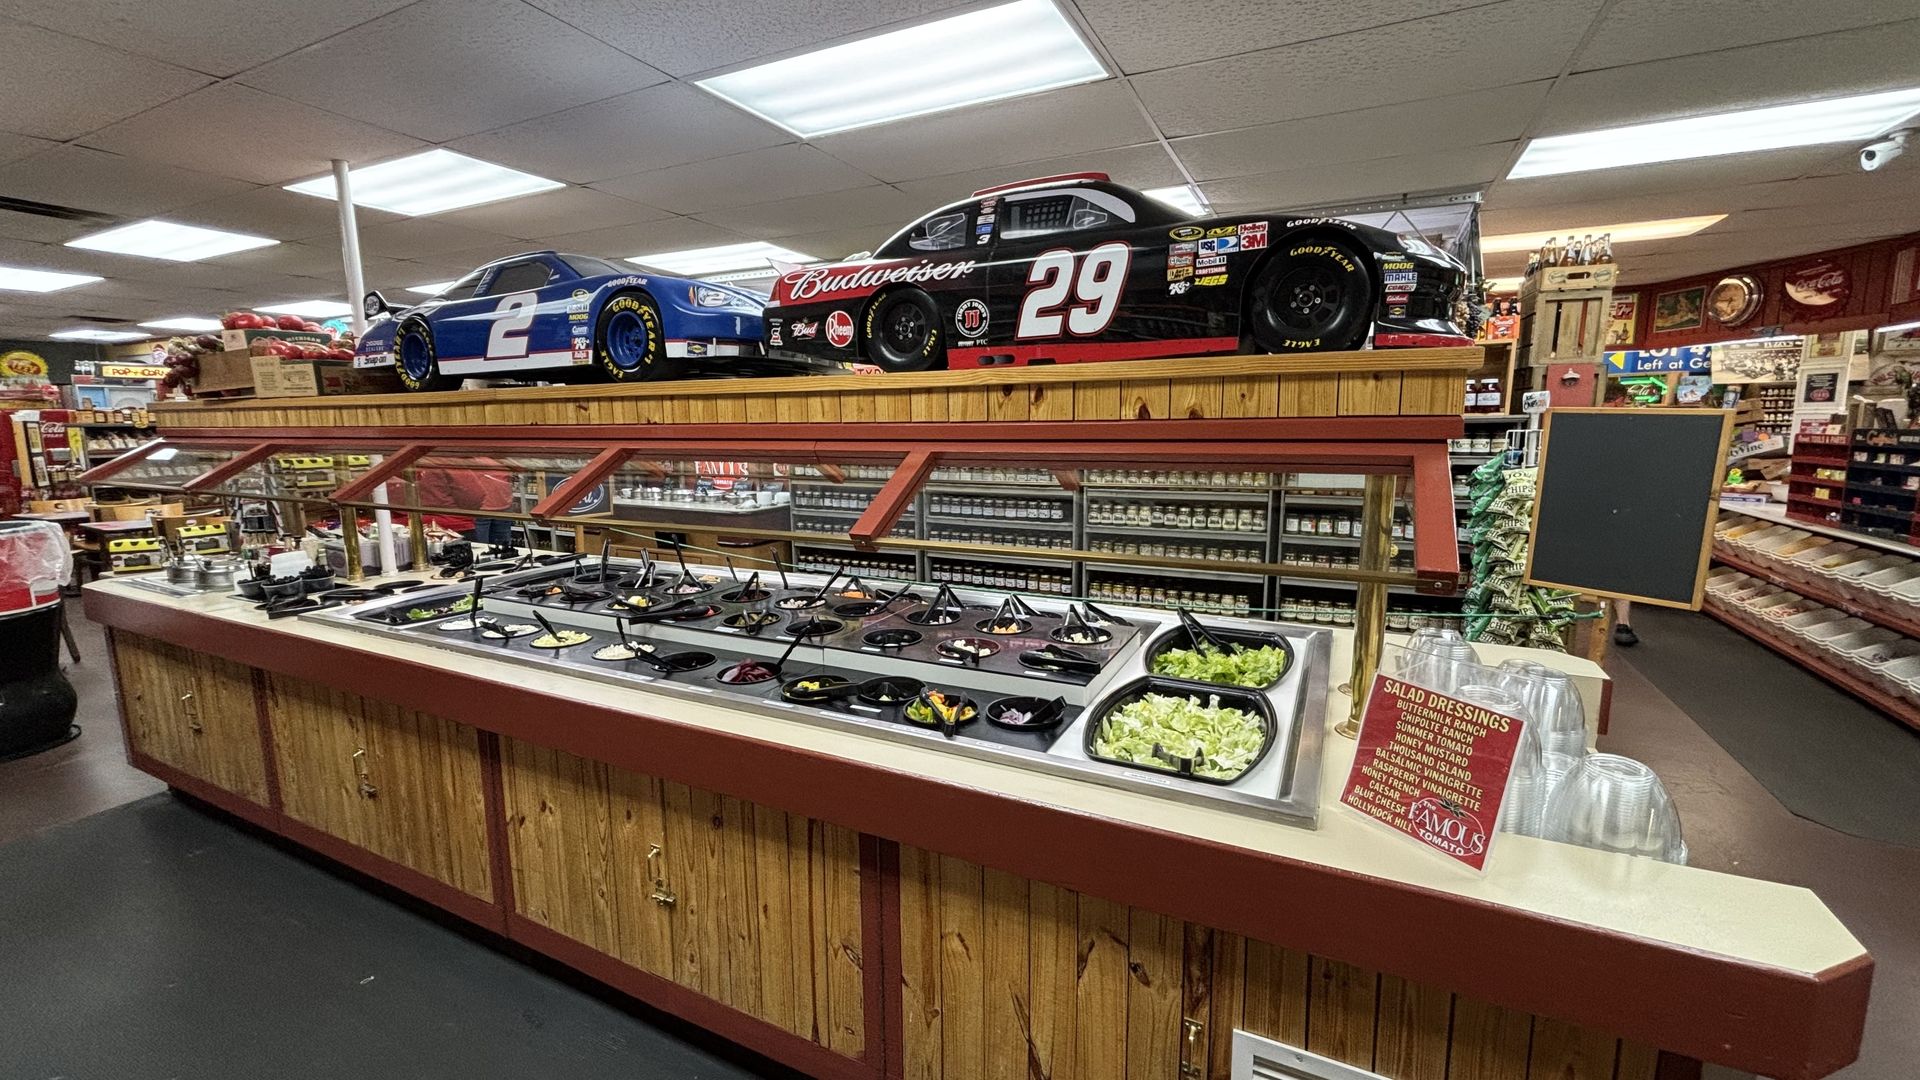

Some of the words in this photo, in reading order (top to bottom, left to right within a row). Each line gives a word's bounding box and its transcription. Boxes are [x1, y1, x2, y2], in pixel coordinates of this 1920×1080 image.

[1286, 217, 1357, 230] GOODYEAR
[976, 234, 991, 245] 3
[1200, 240, 1216, 252] USG
[1242, 234, 1266, 249] 3M
[1198, 258, 1217, 266] Mobil
[1290, 246, 1355, 273] GOODYEAR
[607, 276, 648, 288] GOODYEAR
[784, 259, 976, 300] Budweiser
[1385, 273, 1417, 281] MAHLE
[1014, 240, 1132, 341] 29
[483, 291, 538, 361] 2
[612, 299, 656, 352] GOODYEAR
[791, 321, 819, 337] Bud
[828, 312, 853, 341] Rheem
[1282, 338, 1321, 348] EAGLE
[1637, 359, 1663, 371] Left
[1669, 361, 1684, 370] at
[1493, 500, 1515, 511] HIPS
[1487, 529, 1507, 541] HIPS
[1503, 519, 1526, 528] HIPS
[1508, 562, 1525, 571] HIP
[1492, 594, 1515, 604] HIPS
[1481, 633, 1502, 645] HIPS
[1489, 620, 1516, 635] CHIPS
[1383, 679, 1425, 704] SALAD
[1427, 692, 1511, 733] DRESSINGS
[1396, 699, 1452, 724] BUTTERMILK
[1453, 718, 1487, 739] RANCH
[1401, 712, 1440, 733] CHIPOLTE
[1442, 726, 1473, 745] RANCH
[1395, 732, 1423, 749] HONEY
[1424, 742, 1469, 767] MUSTARD
[1396, 721, 1434, 741] SUMMER
[1436, 735, 1473, 756] TOMATO
[1389, 741, 1435, 767] THOUSAND
[1436, 760, 1472, 781] ISLAND
[1361, 765, 1387, 782] HONEY
[1388, 776, 1421, 798] FRENCH
[1372, 759, 1421, 785] RASPBERRY
[1422, 776, 1481, 812] VINAIGRETTE
[1375, 747, 1423, 775] BALSALMIC
[1424, 764, 1483, 800] VINAIGRETTE
[1354, 785, 1374, 801] BLUE
[1375, 794, 1407, 815] CHEESE
[1369, 780, 1401, 801] CAESAR
[1347, 794, 1394, 823] HOLLYHOCK
[1394, 815, 1413, 834] HILL
[1423, 800, 1436, 811] The
[1408, 802, 1486, 854] FAMOUS
[1418, 828, 1465, 856] TOMATO
